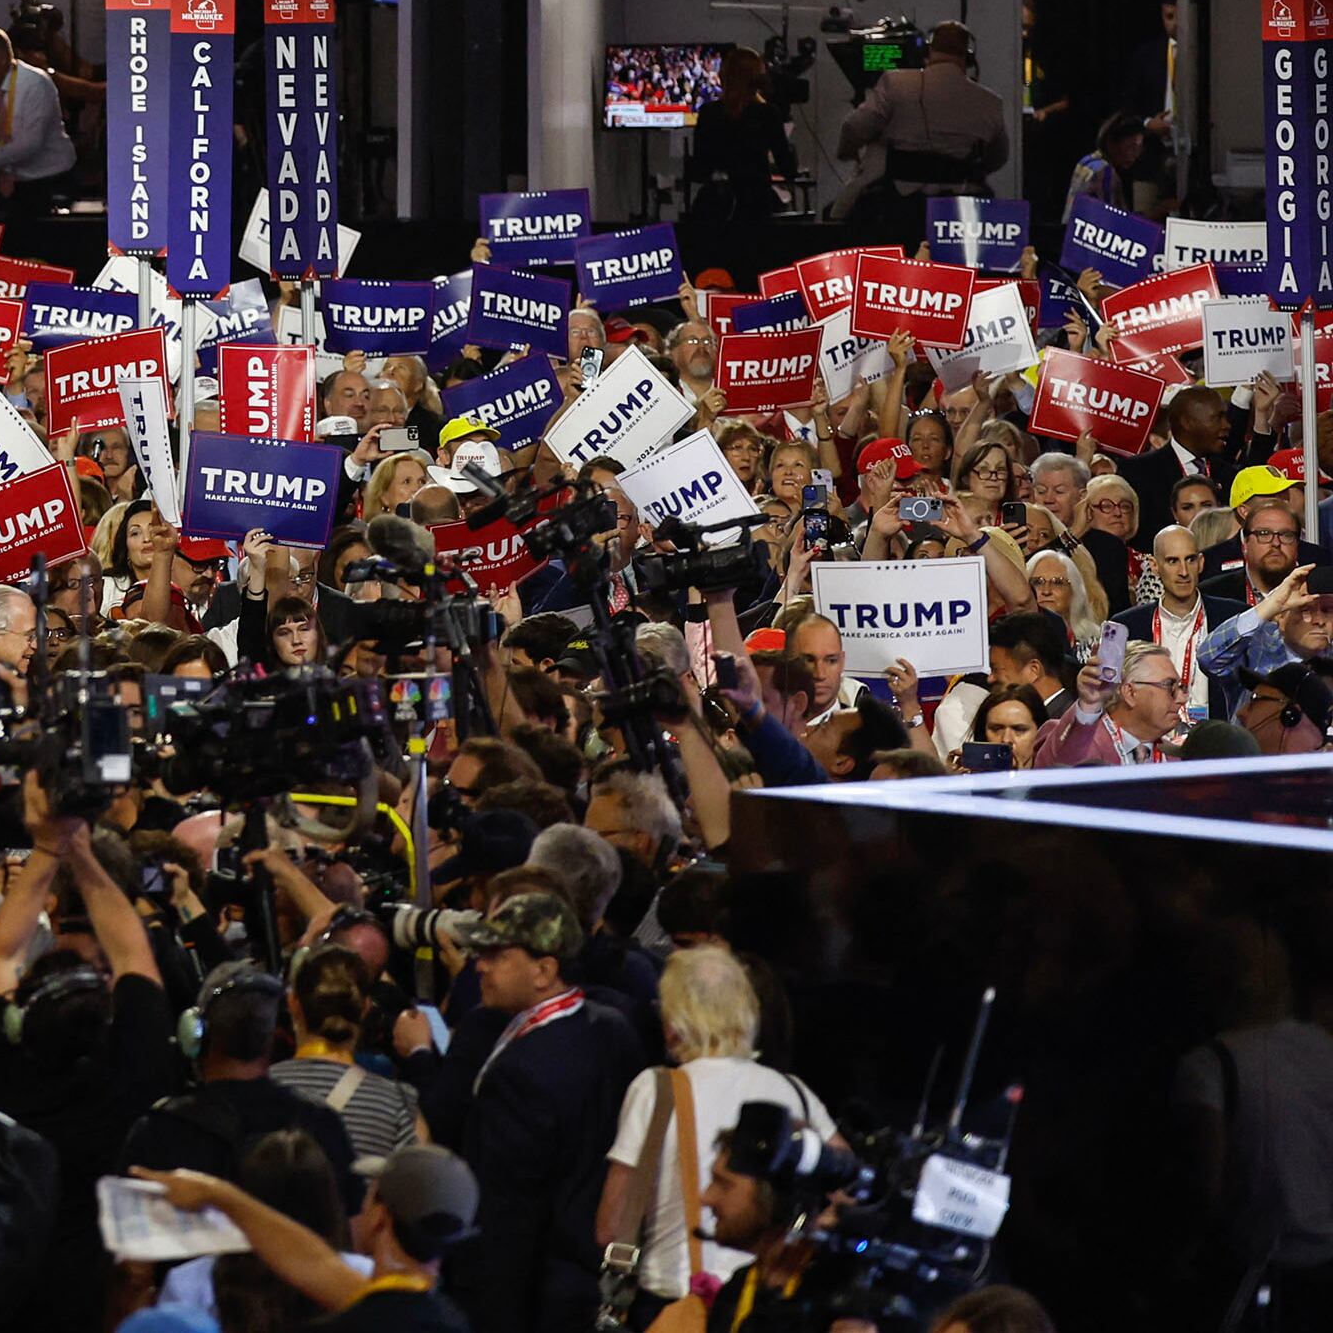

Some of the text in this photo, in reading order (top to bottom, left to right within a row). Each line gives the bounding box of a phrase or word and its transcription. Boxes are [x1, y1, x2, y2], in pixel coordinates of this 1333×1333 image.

[182, 13, 224, 21] MILWAUKEE
[130, 17, 150, 240] RHODE ISLAND
[189, 42, 212, 280] CALIFORNIA
[276, 35, 301, 261] NEVADA
[313, 35, 332, 260] NEVADA
[1274, 48, 1298, 294] GEORGIA
[1313, 48, 1332, 293] GEORGIA
[489, 214, 582, 237] TRUMP
[934, 221, 1021, 240] TRUMP
[1073, 218, 1147, 260] TRUMP
[586, 248, 673, 280] TRUMP
[1174, 245, 1264, 263] TRUMP
[480, 291, 562, 324] TRUMP
[863, 281, 962, 312] TRUMP
[1113, 289, 1211, 329] TRUMP
[32, 304, 134, 333] TRUMP
[329, 303, 426, 326] TRUMP
[1213, 326, 1286, 348] TRUMP
[726, 354, 812, 379] TRUMP
[1050, 378, 1149, 420] TRUMP
[97, 417, 120, 427] 2024
[569, 379, 654, 464] TRUMP
[636, 446, 655, 464] 2024
[201, 467, 326, 502] TRUMP
[205, 494, 317, 512] MAKE AMERICA GREAT AGAIN!
[15, 535, 37, 547] GREAT
[39, 522, 64, 536] AGAIN!
[6, 569, 30, 582] 2024
[830, 599, 971, 628] TRUMP
